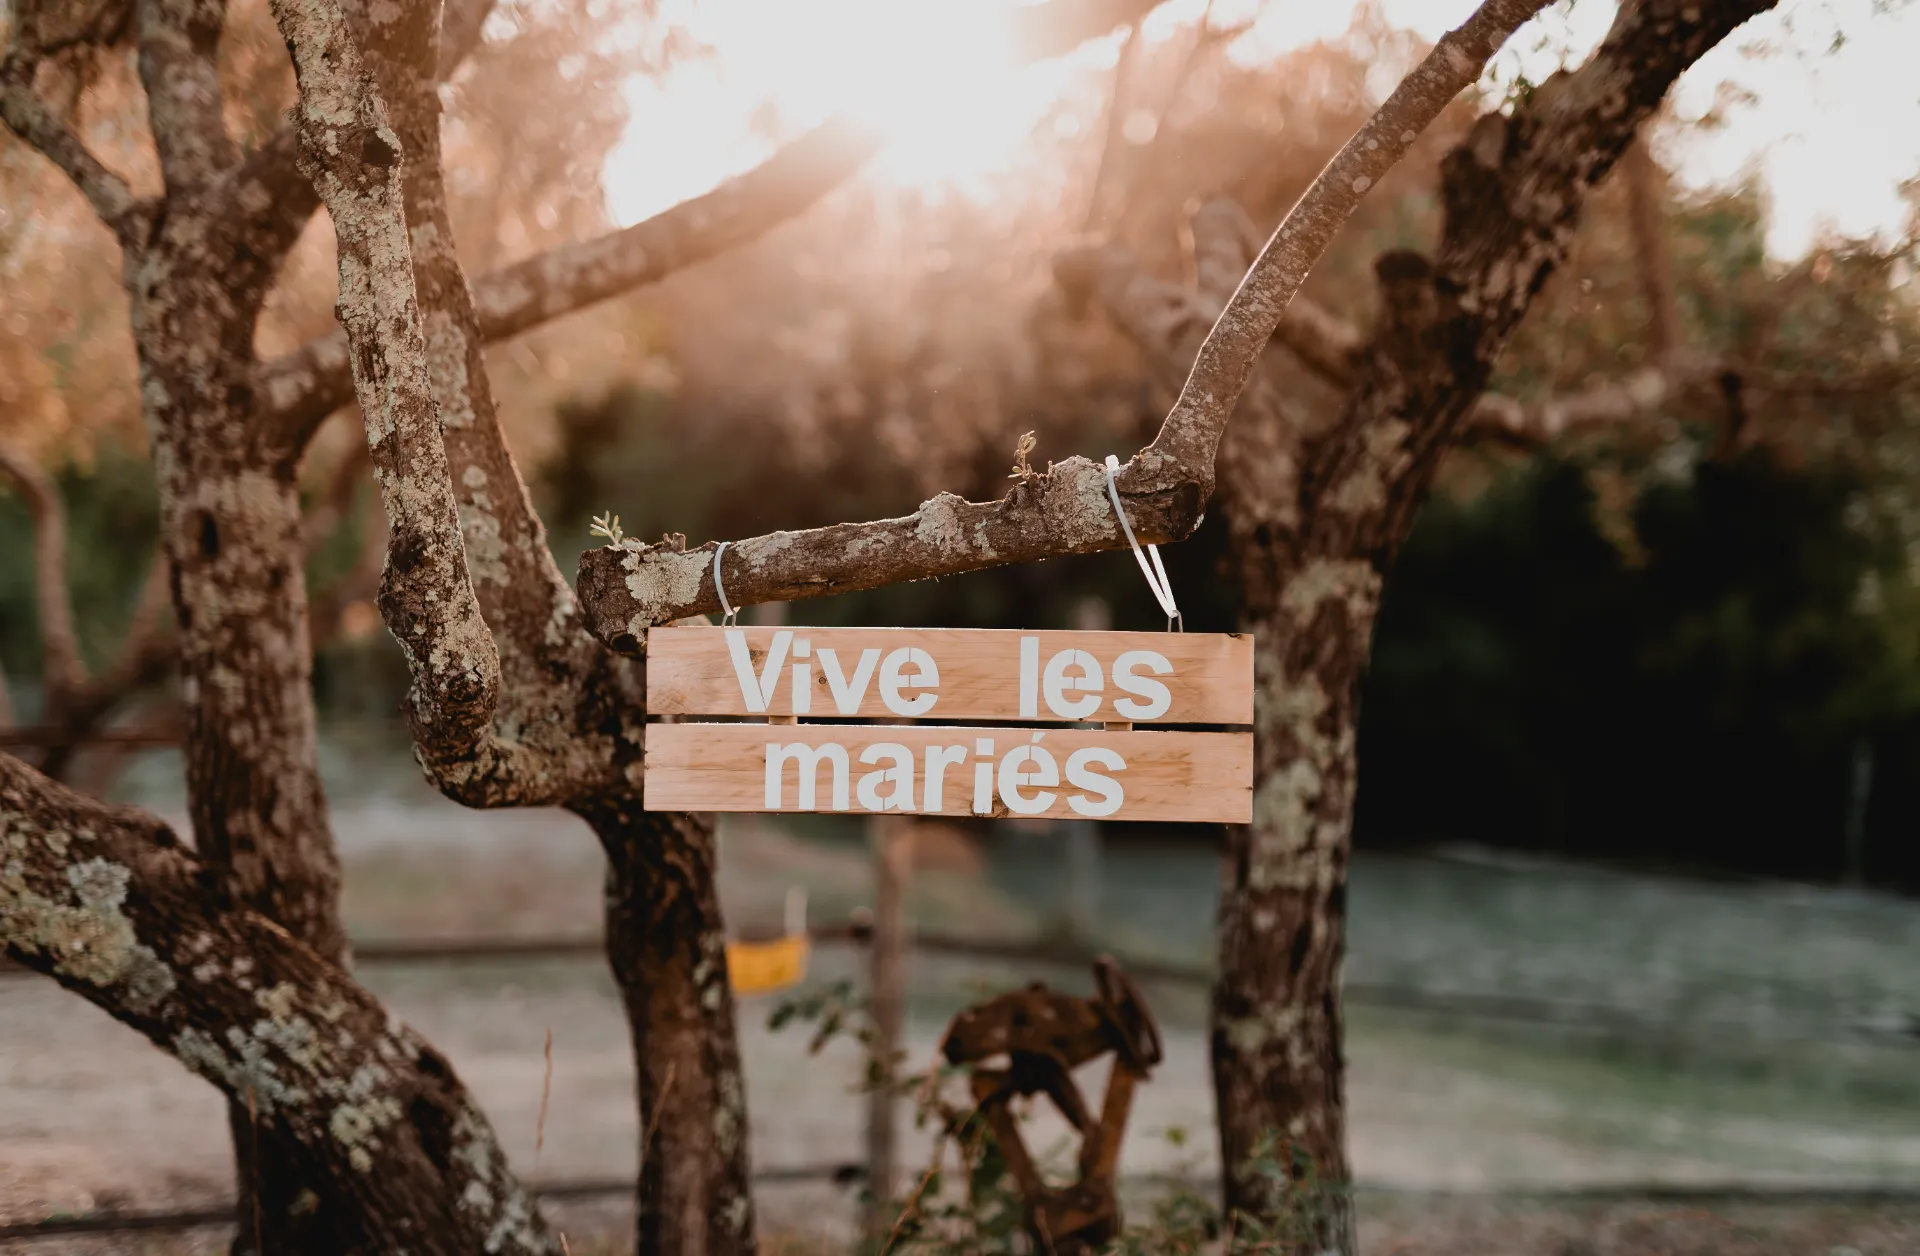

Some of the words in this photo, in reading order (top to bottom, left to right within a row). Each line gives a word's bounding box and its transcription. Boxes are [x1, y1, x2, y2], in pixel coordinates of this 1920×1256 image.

[725, 630, 940, 717] Vive
[1019, 636, 1174, 720] les
[764, 731, 1127, 817] mariés
